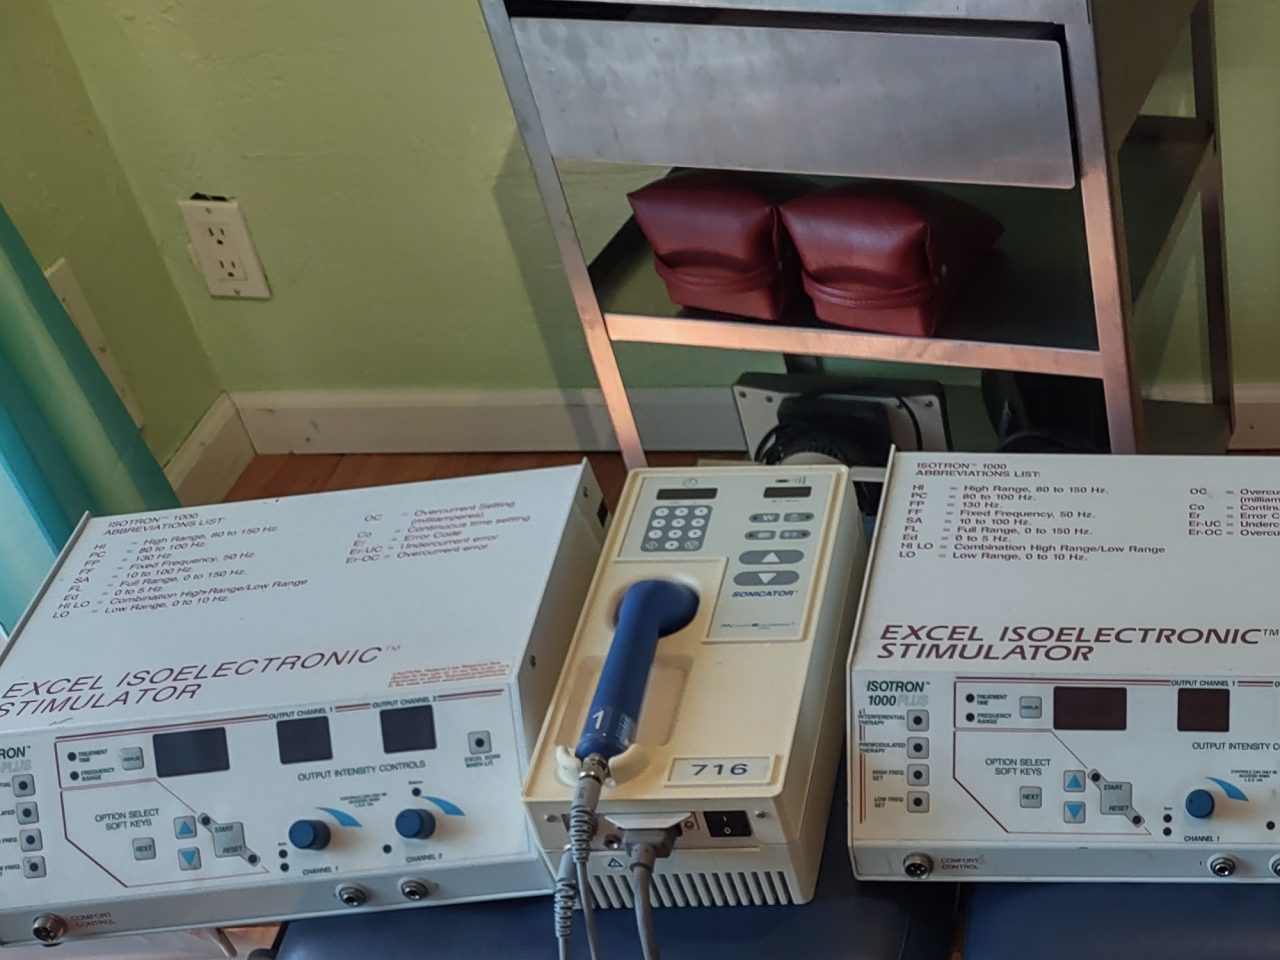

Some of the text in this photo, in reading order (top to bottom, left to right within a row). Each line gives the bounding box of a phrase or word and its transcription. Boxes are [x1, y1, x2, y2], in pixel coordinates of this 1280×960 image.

[915, 470, 1010, 478] ABBREVIATIONS
[1240, 512, 1267, 520] Error
[880, 624, 984, 642] EXCEL
[876, 643, 1095, 661] STIMULATOR
[2, 674, 103, 699] EXCEL
[0, 683, 202, 718] STIMULATOR
[868, 695, 897, 706] 1000
[592, 709, 605, 730] 1
[1192, 742, 1226, 751] OUTPUT
[1228, 742, 1271, 751] INTENSITY
[985, 758, 1051, 767] OPTION SELECT
[298, 760, 426, 781] OUTPUT INTENSITY CONTROLS
[691, 764, 748, 776] 716
[995, 767, 1042, 776] SOFT KEYS
[95, 808, 160, 822] OPTION SELECT
[105, 818, 152, 831] SOFT KEYS
